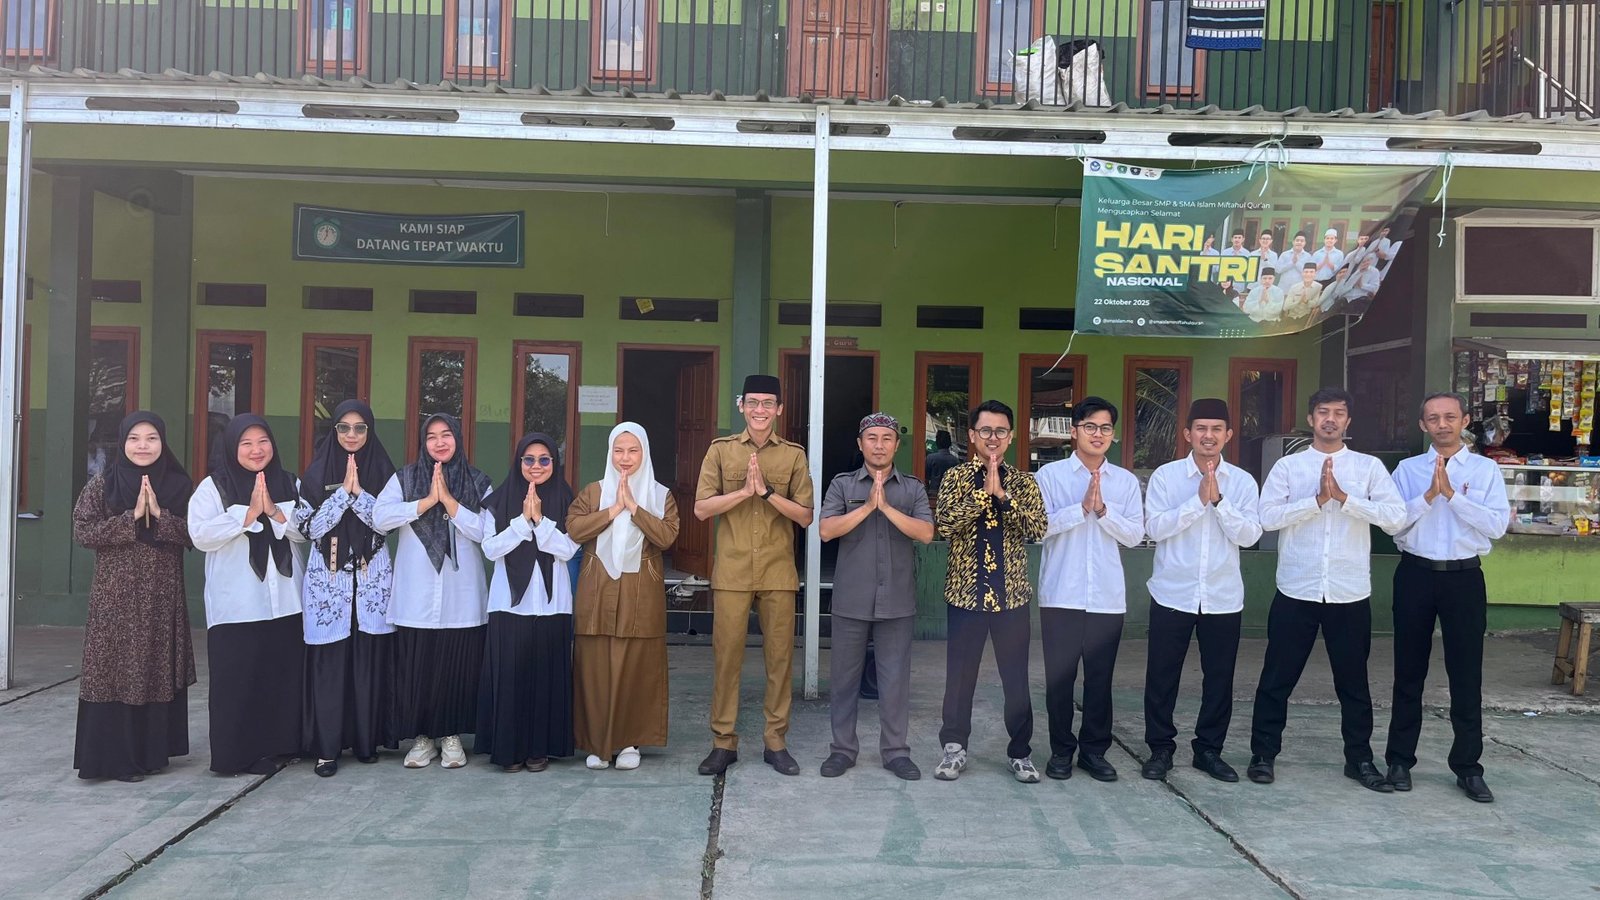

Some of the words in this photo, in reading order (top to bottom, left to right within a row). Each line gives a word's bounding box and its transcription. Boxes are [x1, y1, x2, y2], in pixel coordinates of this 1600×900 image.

[1098, 197, 1131, 208] Keluarga
[1132, 199, 1153, 207] Besar
[1197, 201, 1216, 209] Islam
[1247, 202, 1271, 210] Qur'an
[1097, 207, 1150, 217] Mengucapkan
[1150, 209, 1181, 217] Selamat
[400, 223, 433, 234] KAMI
[436, 224, 465, 235] SIAP
[1095, 220, 1205, 251] HARI
[356, 238, 410, 251] DATANG
[413, 240, 453, 252] TEPAT
[456, 241, 504, 253] WAKTU
[1094, 252, 1261, 283] SANTRI
[1106, 276, 1183, 287] NASIONAL
[1103, 298, 1131, 306] Oktober
